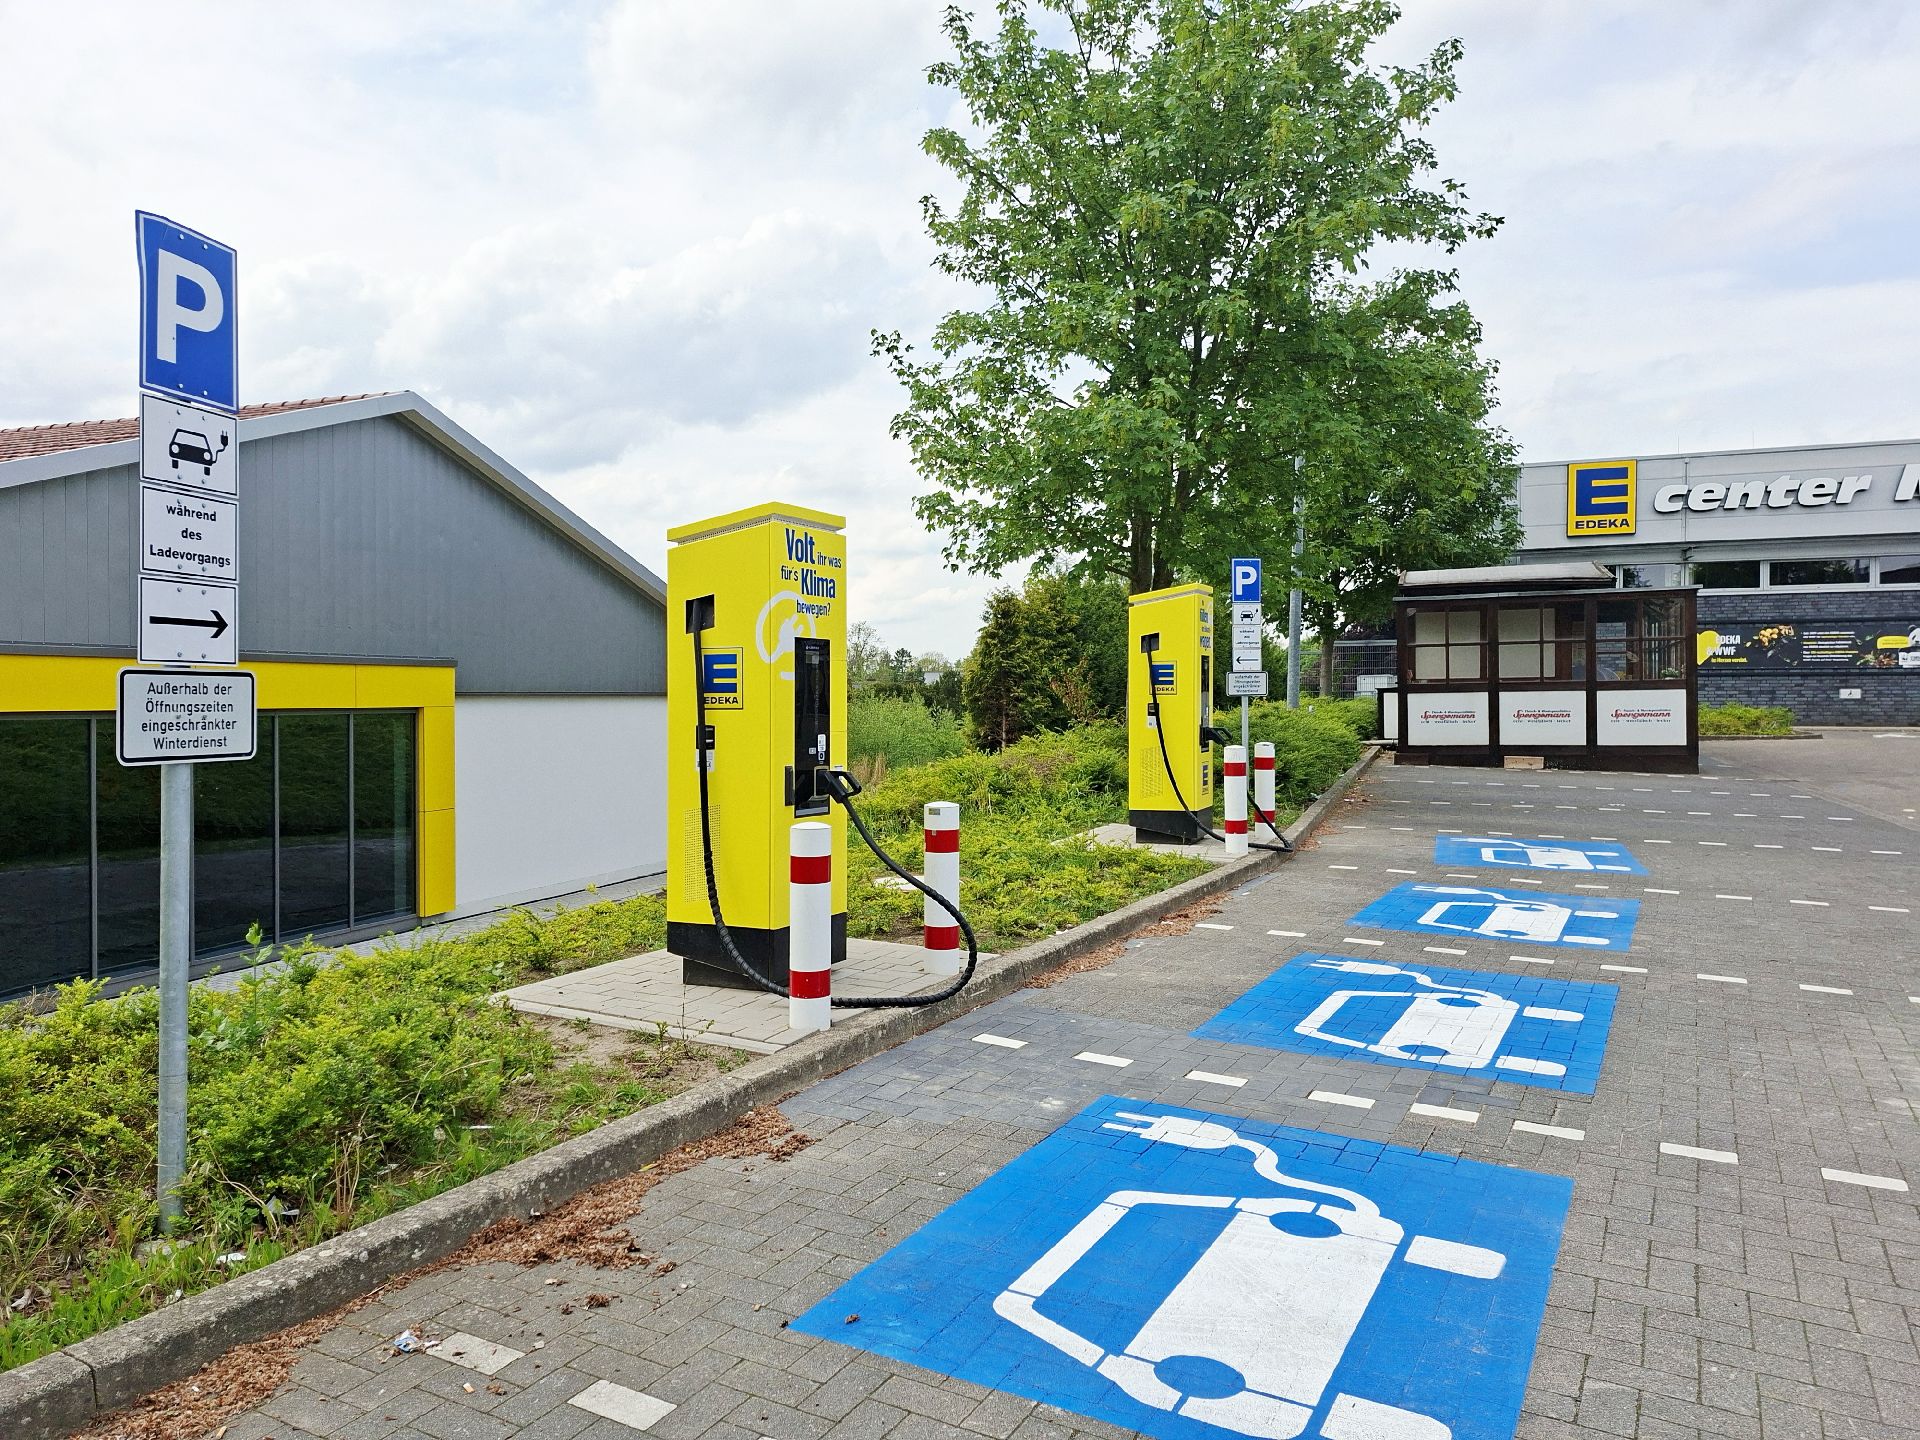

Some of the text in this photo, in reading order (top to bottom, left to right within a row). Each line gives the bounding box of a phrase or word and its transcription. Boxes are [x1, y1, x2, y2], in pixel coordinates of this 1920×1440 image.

[157, 248, 224, 364] P
[1575, 467, 1629, 516] E
[1653, 475, 1873, 513] center
[166, 504, 217, 522] während
[1575, 518, 1630, 529] EDEKA
[181, 527, 202, 541] des
[149, 544, 231, 568] Ladevorgangs
[785, 527, 842, 569] Volt ihr was
[801, 567, 836, 599] Klima
[1235, 565, 1258, 596] P
[796, 599, 831, 619] bewegen?
[1715, 646, 1737, 656] WWF
[703, 654, 738, 693] E
[147, 682, 233, 696] Außerhalb der
[145, 697, 234, 716] Öffnungszeiten
[704, 697, 739, 705] EDEKA
[141, 717, 238, 735] eingeschränkter
[153, 736, 228, 750] Winterdienst
